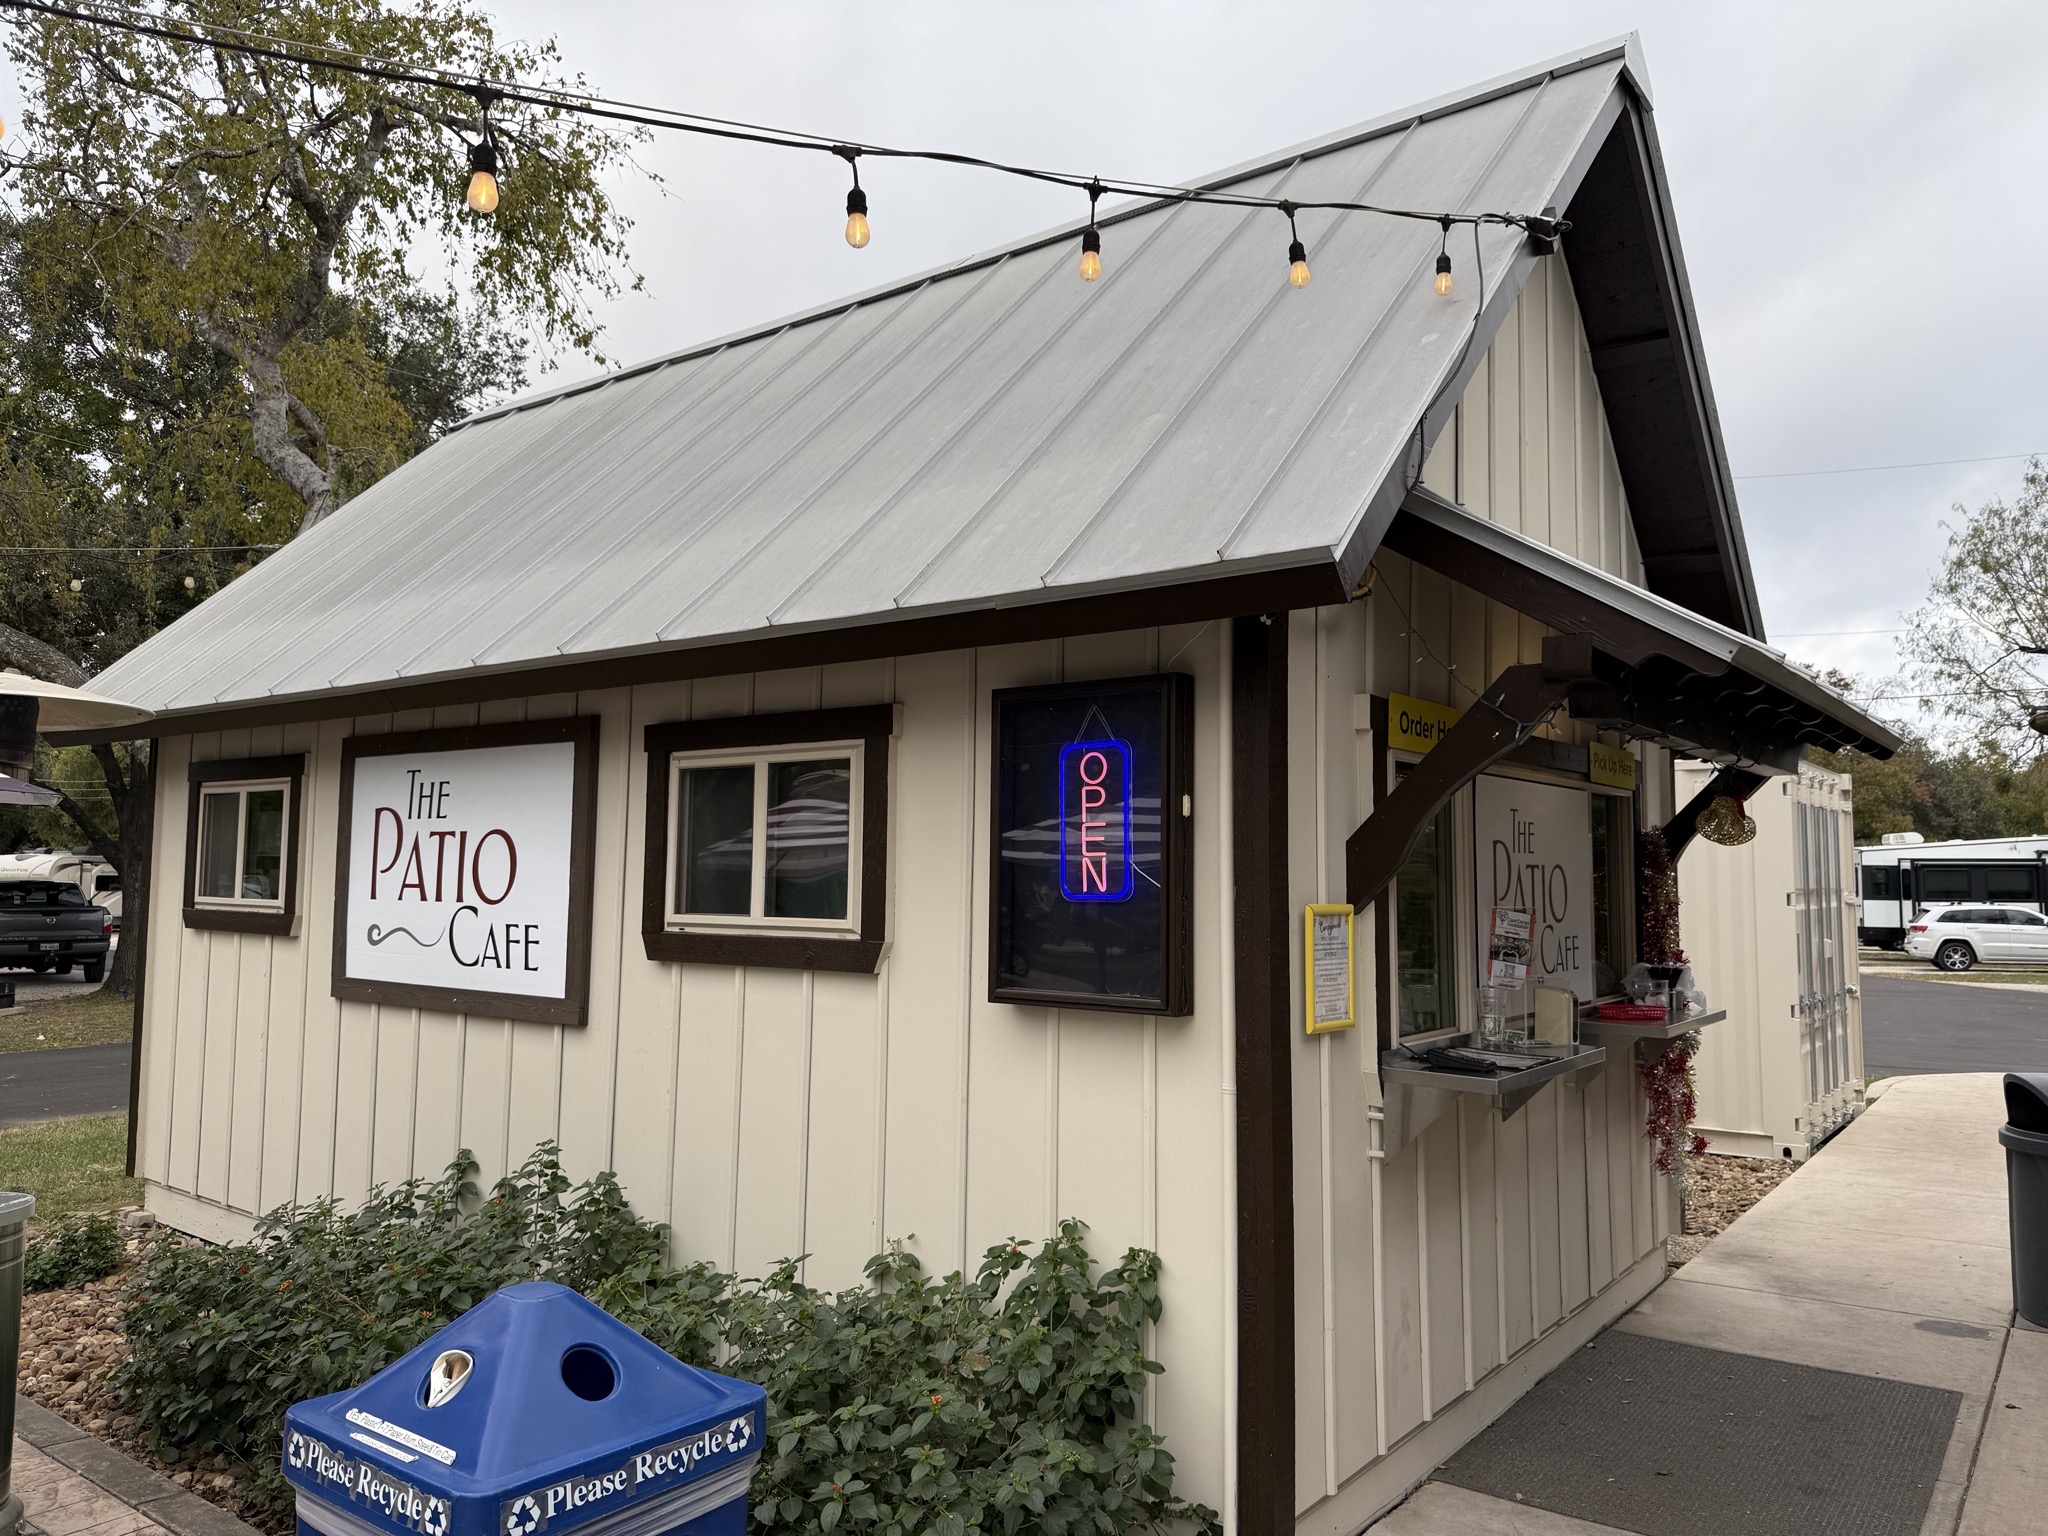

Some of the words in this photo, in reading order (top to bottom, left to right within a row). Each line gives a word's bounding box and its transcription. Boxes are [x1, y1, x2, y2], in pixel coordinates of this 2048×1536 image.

[1400, 711, 1434, 740] Order
[406, 769, 450, 820] THE
[1593, 752, 1607, 770] Pick
[1608, 757, 1618, 777] Up
[1619, 759, 1632, 777] Here
[370, 806, 518, 905] PATIO
[1079, 751, 1108, 893] OPEN
[1510, 809, 1535, 854] THE
[1492, 840, 1568, 924] PATIO
[449, 905, 540, 972] CAFE
[1541, 924, 1580, 974] CAFE
[306, 1441, 354, 1488] Please
[356, 1464, 422, 1521] Recycle
[545, 1470, 628, 1518] Please
[634, 1432, 723, 1485] Recycle
